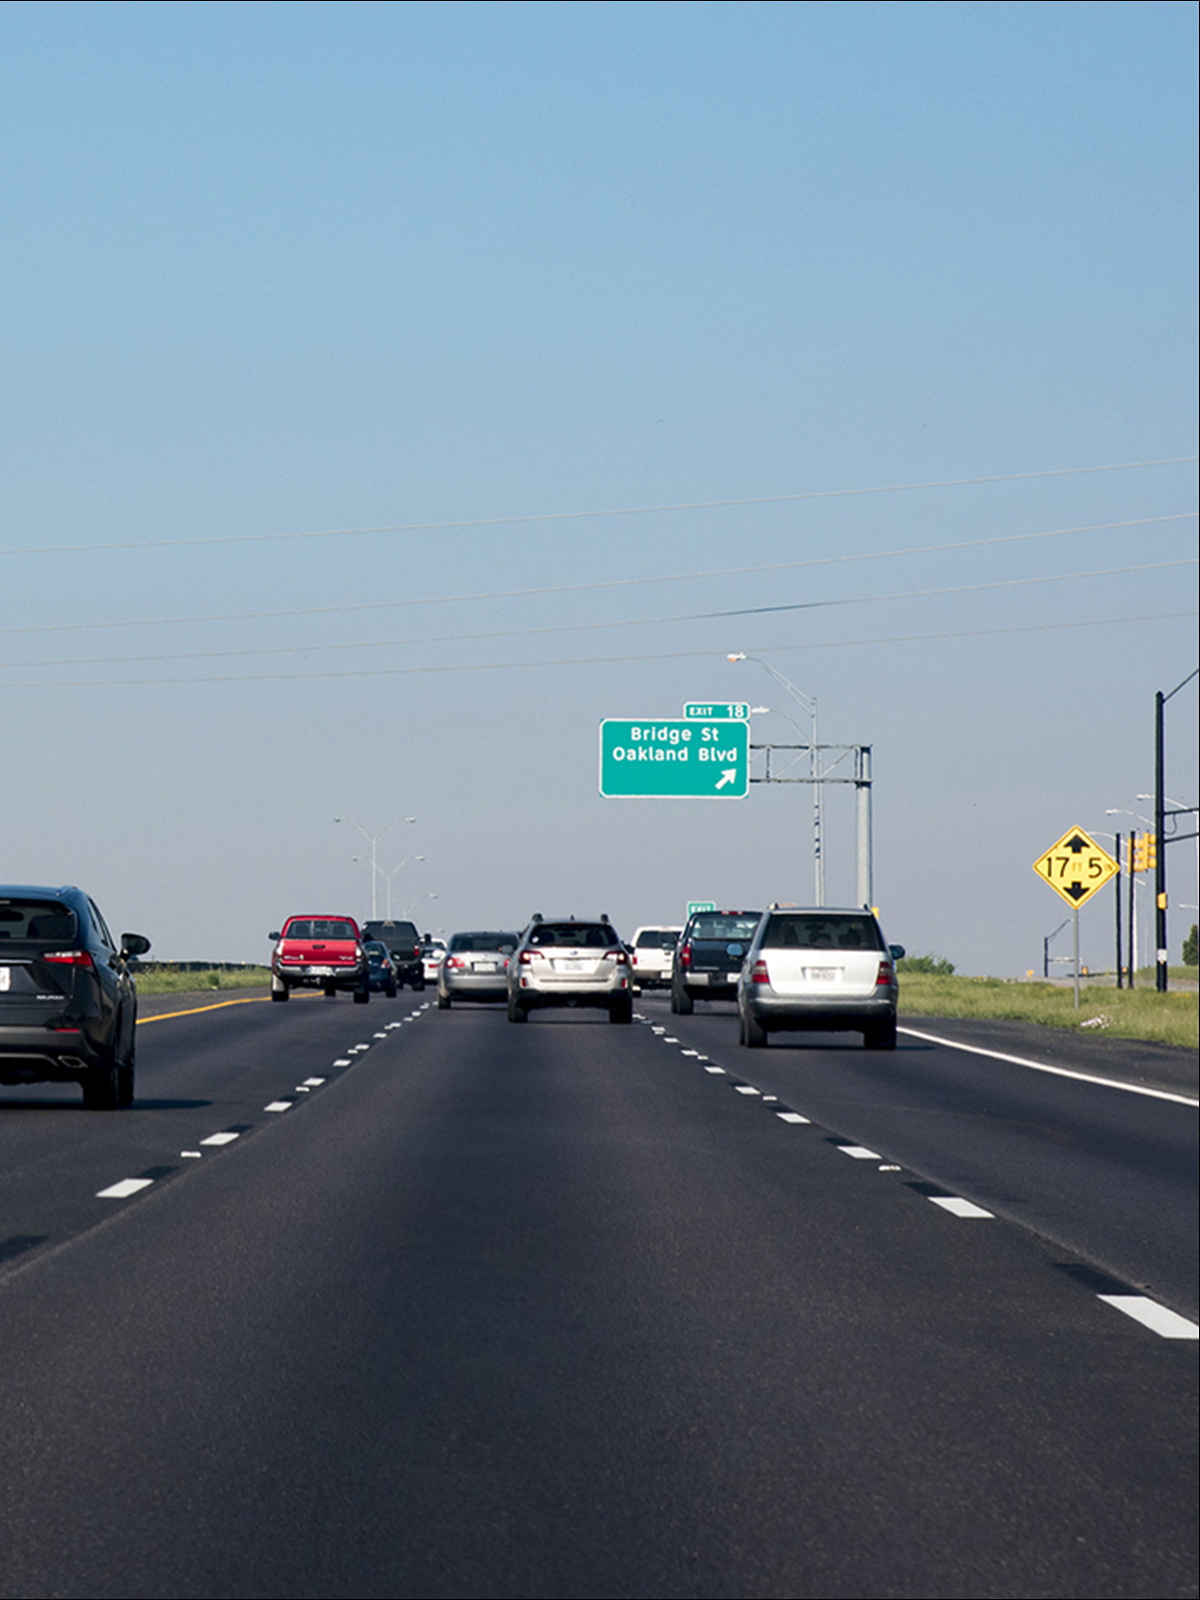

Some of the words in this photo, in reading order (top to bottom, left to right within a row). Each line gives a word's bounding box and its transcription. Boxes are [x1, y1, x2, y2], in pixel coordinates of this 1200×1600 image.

[689, 706, 713, 716] EXIT
[727, 704, 744, 718] 18
[630, 726, 692, 745] Bridge
[701, 727, 719, 741] St
[612, 746, 688, 761] Oakland
[698, 746, 738, 761] Blvd
[1046, 856, 1070, 878] 17
[1088, 857, 1103, 878] 5
